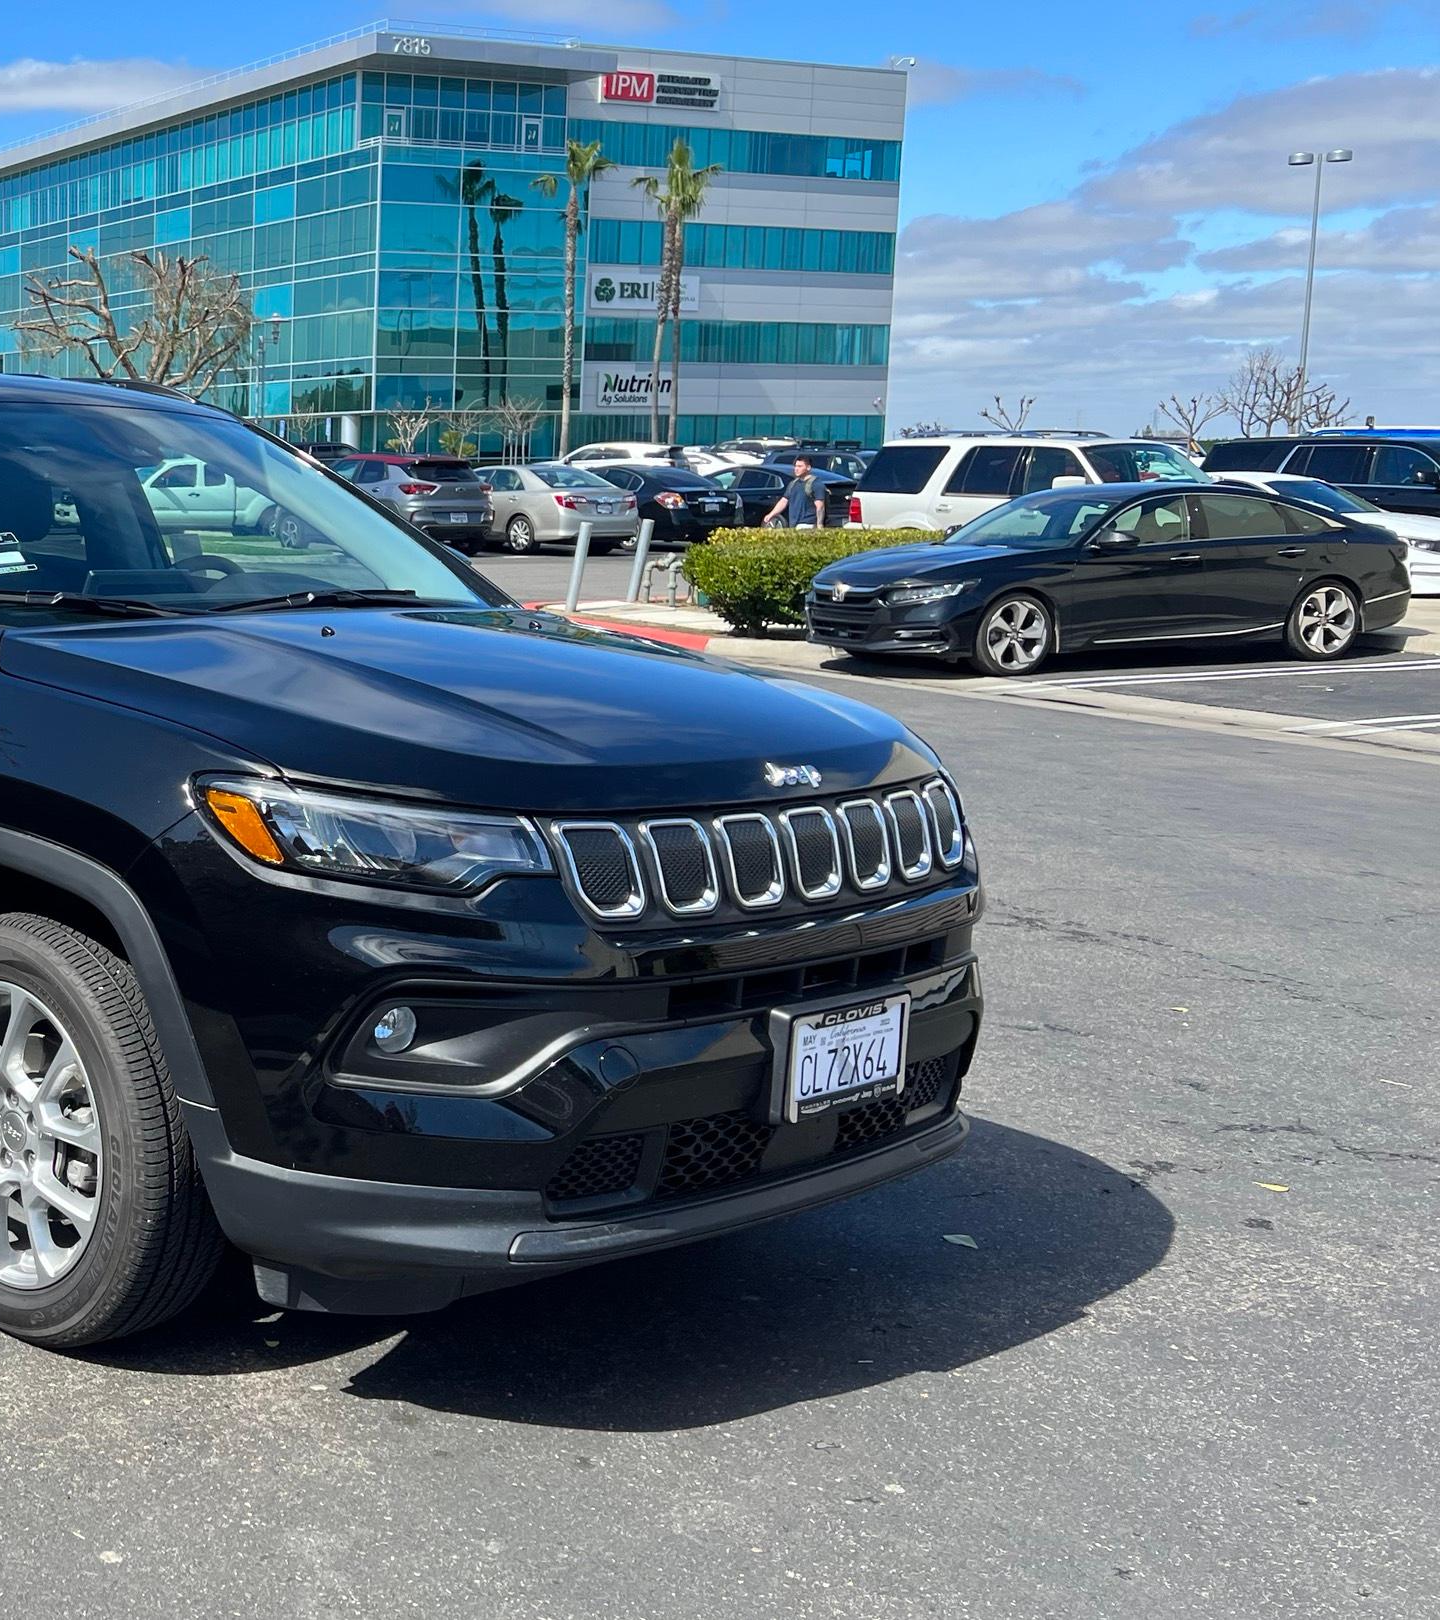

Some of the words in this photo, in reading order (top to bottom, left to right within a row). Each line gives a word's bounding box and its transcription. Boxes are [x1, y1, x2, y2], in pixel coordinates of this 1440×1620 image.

[392, 36, 431, 55] 7815
[610, 74, 650, 98] IPM
[619, 281, 649, 299] ERI
[601, 394, 612, 406] Ag
[613, 394, 648, 404] Solutions
[764, 762, 823, 789] Jeep
[824, 1003, 883, 1026] CLOVIS
[803, 1034, 818, 1047] MAY
[800, 1036, 887, 1096] CL72X64
